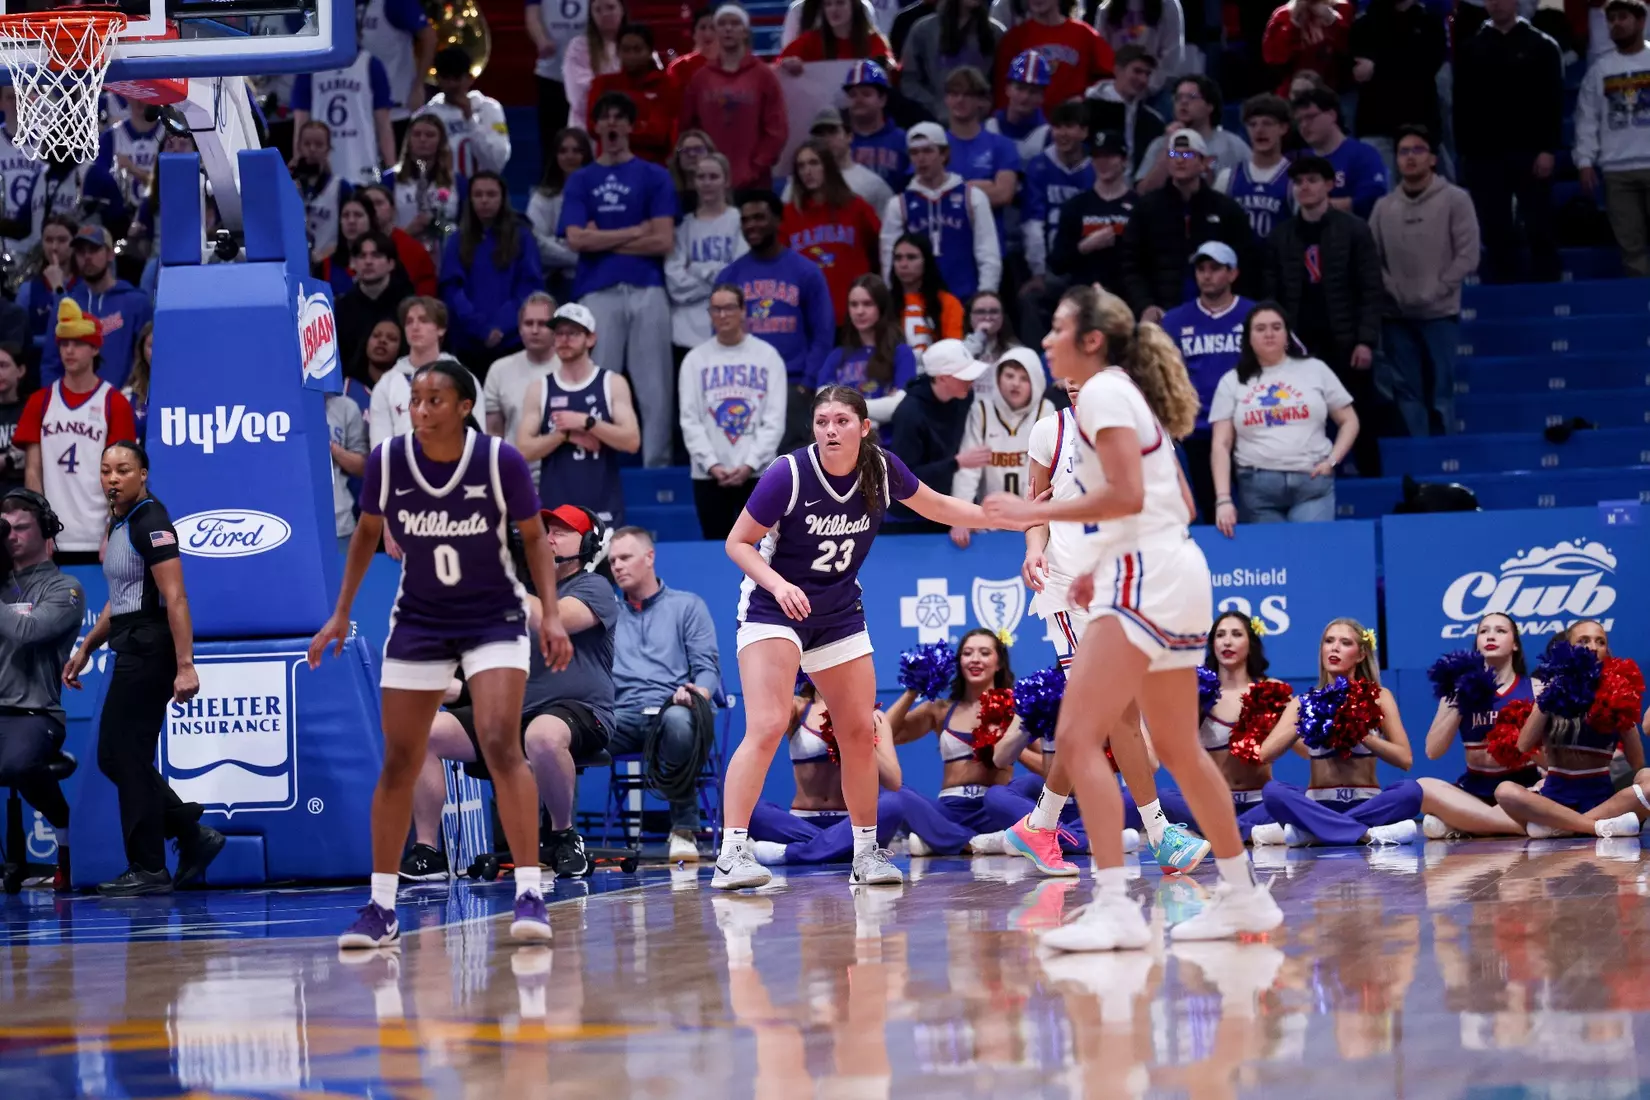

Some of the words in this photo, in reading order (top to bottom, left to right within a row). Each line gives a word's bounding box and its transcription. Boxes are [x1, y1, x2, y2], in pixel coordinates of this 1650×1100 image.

[327, 94, 348, 127] 6
[743, 279, 800, 307] ANSAS
[303, 312, 334, 370] LIBMAN
[701, 364, 768, 392] KANSAS
[42, 420, 103, 442] KANSAS
[57, 442, 79, 474] 4
[189, 517, 265, 548] Ford
[398, 509, 489, 537] Wildcats
[805, 512, 871, 536] Wildcats
[433, 544, 462, 586] 0
[810, 538, 856, 573] 23
[1211, 567, 1287, 587] ueShield
[1442, 570, 1617, 622] Club
[1441, 624, 1480, 639] CA
[171, 695, 282, 719] SHELTER
[1471, 710, 1499, 730] JAYH
[172, 719, 281, 735] INSURANCE
[1336, 788, 1355, 801] KU
